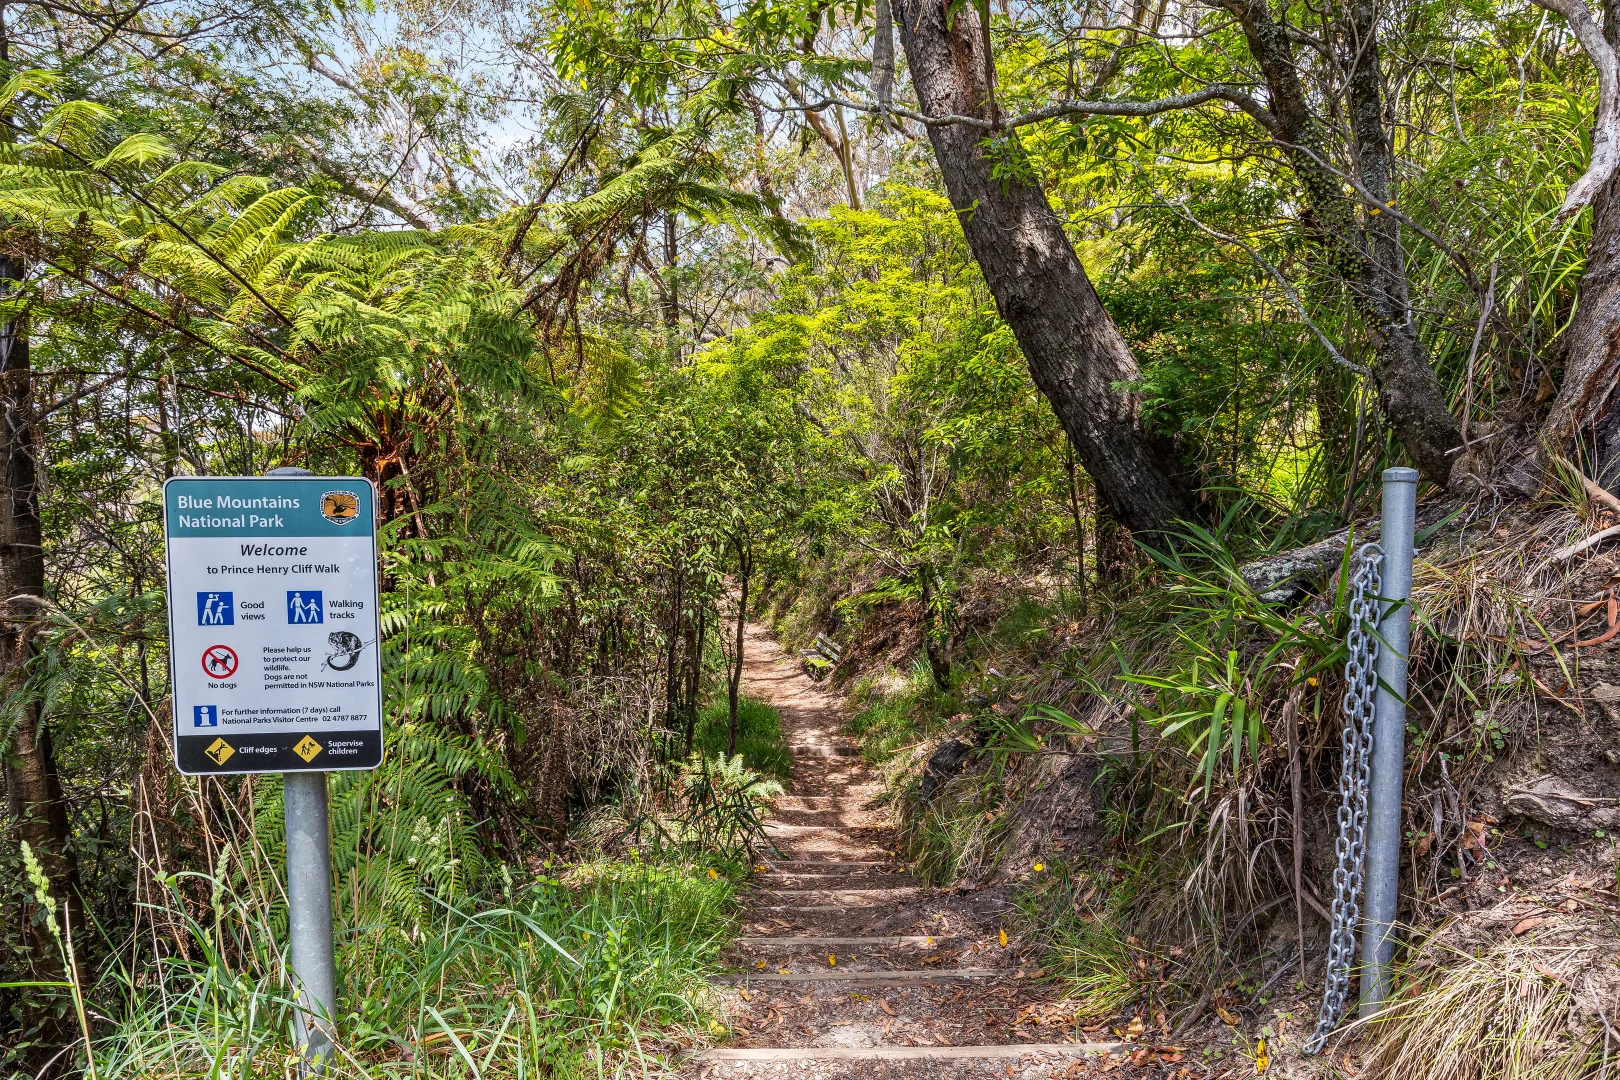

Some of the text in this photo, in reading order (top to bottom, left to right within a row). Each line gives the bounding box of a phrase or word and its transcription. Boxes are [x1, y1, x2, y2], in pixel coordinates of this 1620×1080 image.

[178, 496, 300, 509] Blue Mountains
[179, 514, 284, 528] National Park
[240, 544, 308, 556] Welcome
[207, 564, 340, 576] to Prince Henry Cliff Walk
[329, 600, 364, 609] Walking
